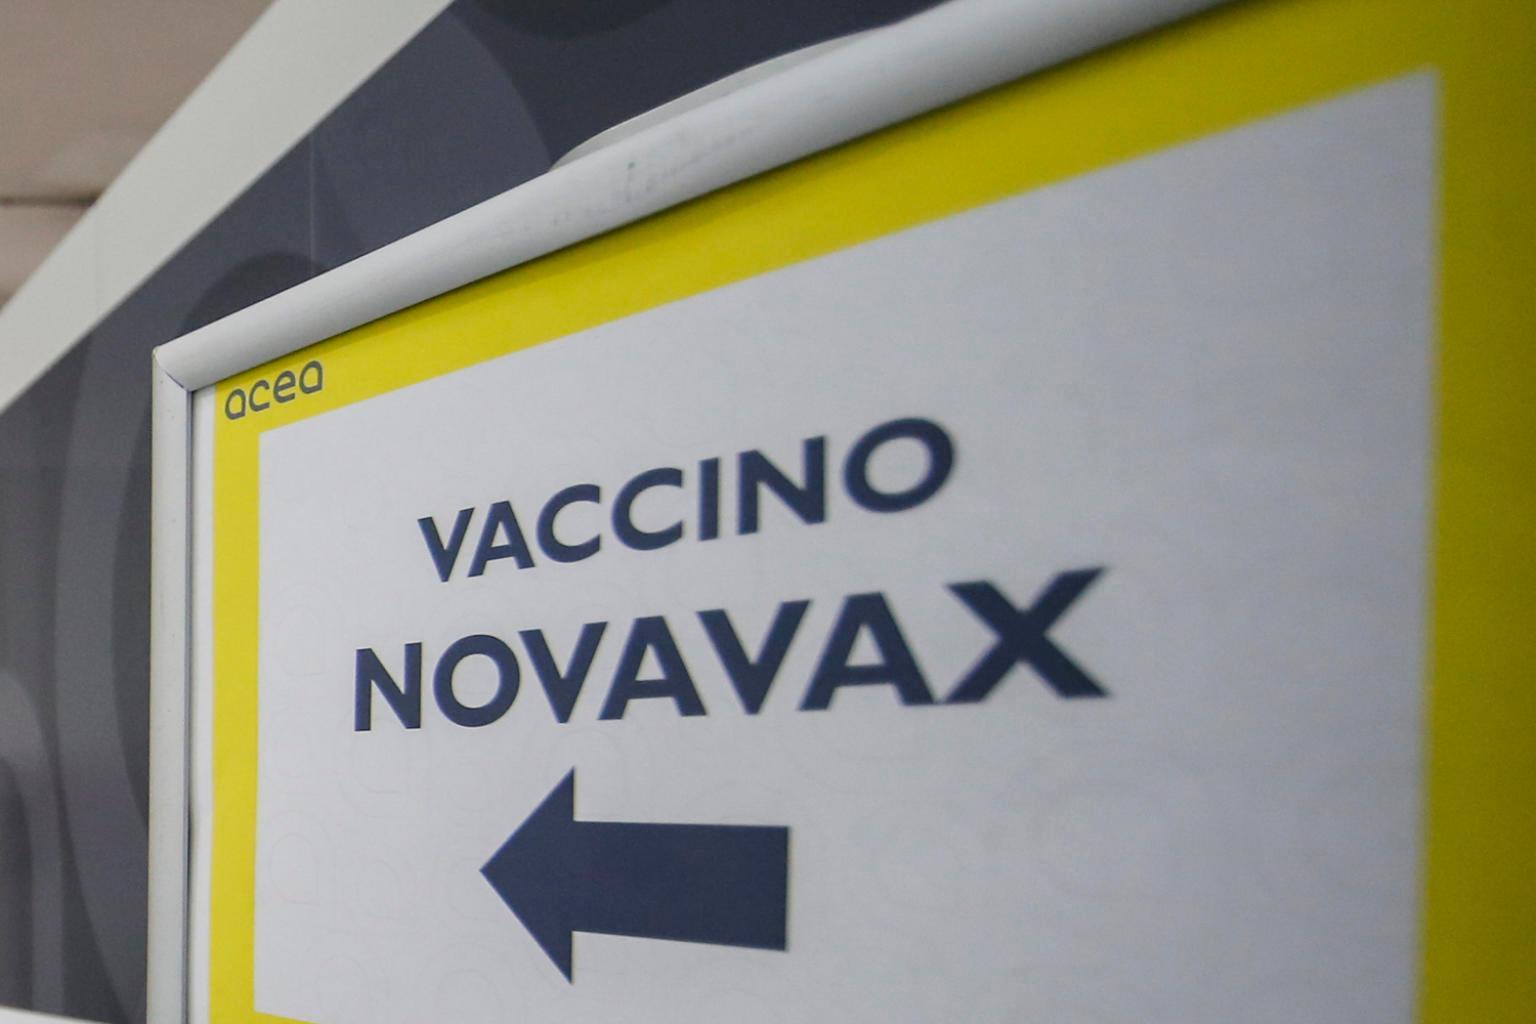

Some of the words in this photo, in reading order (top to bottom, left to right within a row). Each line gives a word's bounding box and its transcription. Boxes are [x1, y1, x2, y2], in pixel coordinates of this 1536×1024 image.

[225, 361, 323, 420] acea
[418, 418, 955, 582] VACCINO
[355, 566, 1111, 731] NOVAVAX
